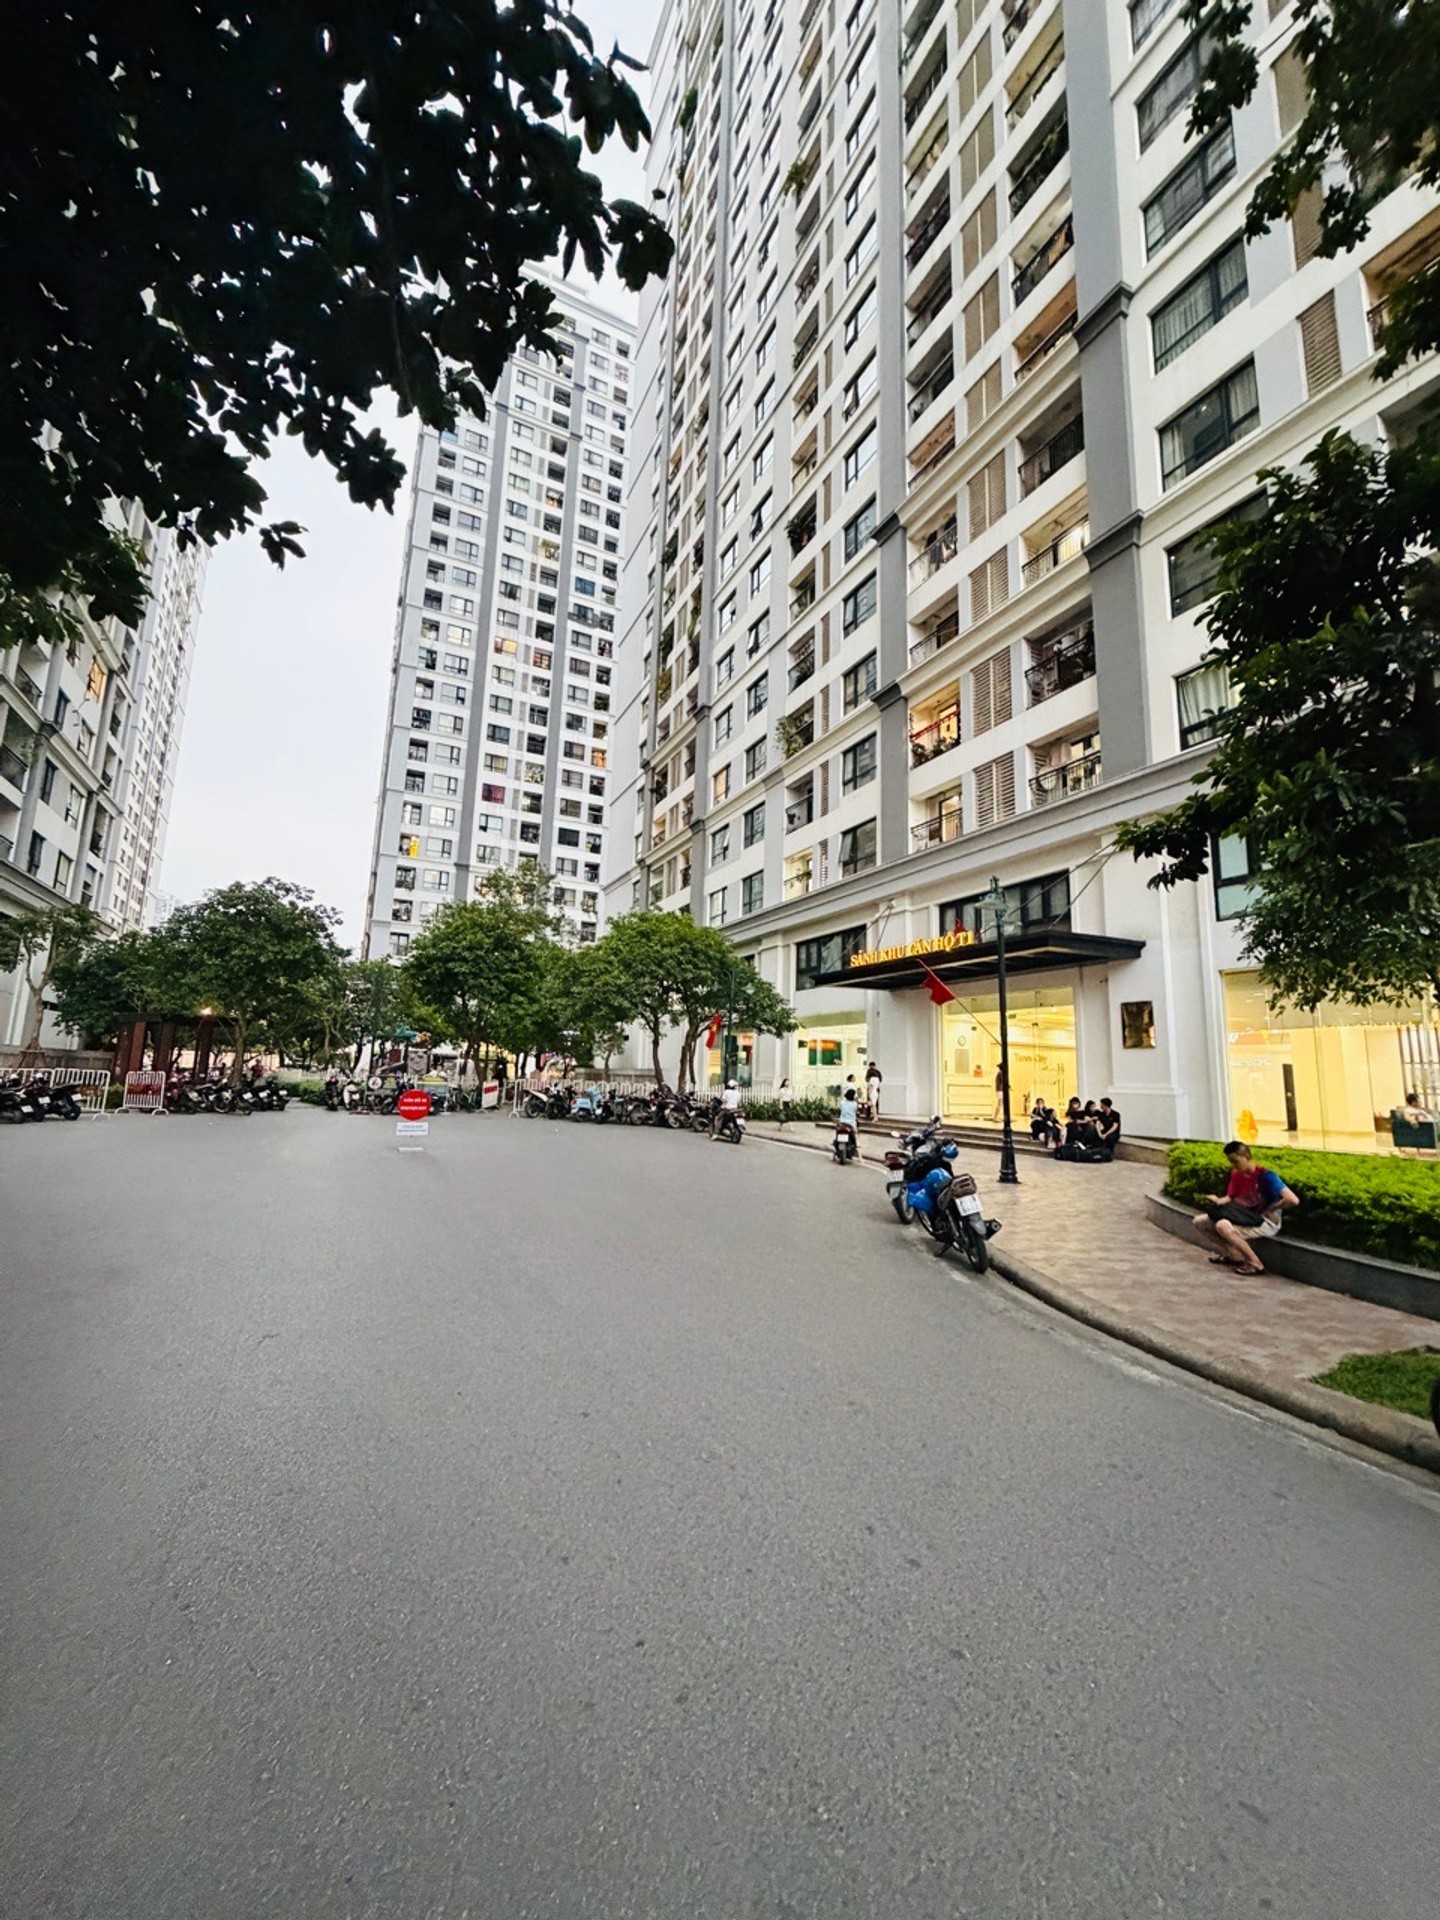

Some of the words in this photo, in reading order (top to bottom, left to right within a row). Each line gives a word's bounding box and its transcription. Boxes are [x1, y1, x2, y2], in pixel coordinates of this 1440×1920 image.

[850, 949, 878, 967] SẢNH
[880, 945, 904, 962] KHU
[906, 938, 932, 956] CĂN
[933, 931, 955, 952] HỘ
